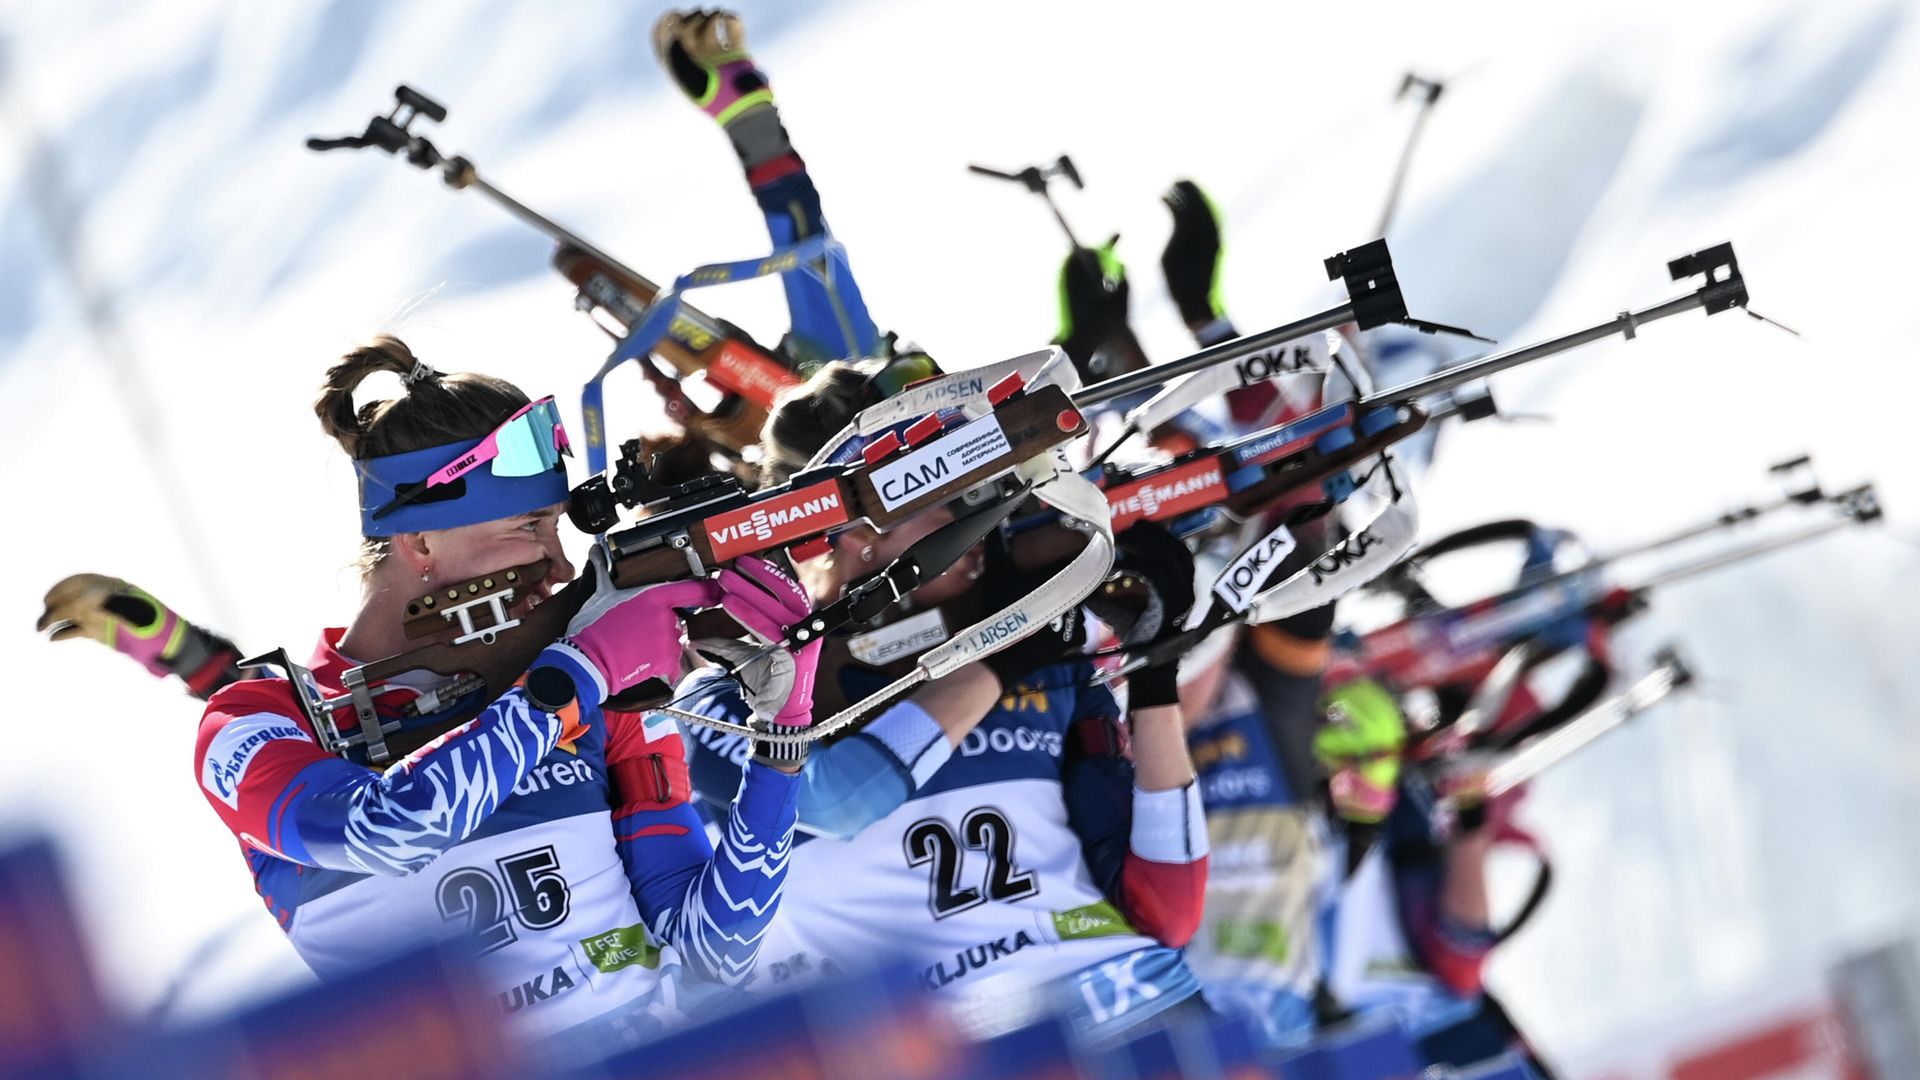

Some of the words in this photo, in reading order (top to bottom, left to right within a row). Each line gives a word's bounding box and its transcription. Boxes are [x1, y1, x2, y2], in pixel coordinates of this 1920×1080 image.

[710, 493, 839, 544] VIESSMANN
[1224, 537, 1286, 603] JOKA
[969, 611, 1028, 652] LARSEN
[902, 806, 1040, 921] 22
[434, 844, 572, 958] 25
